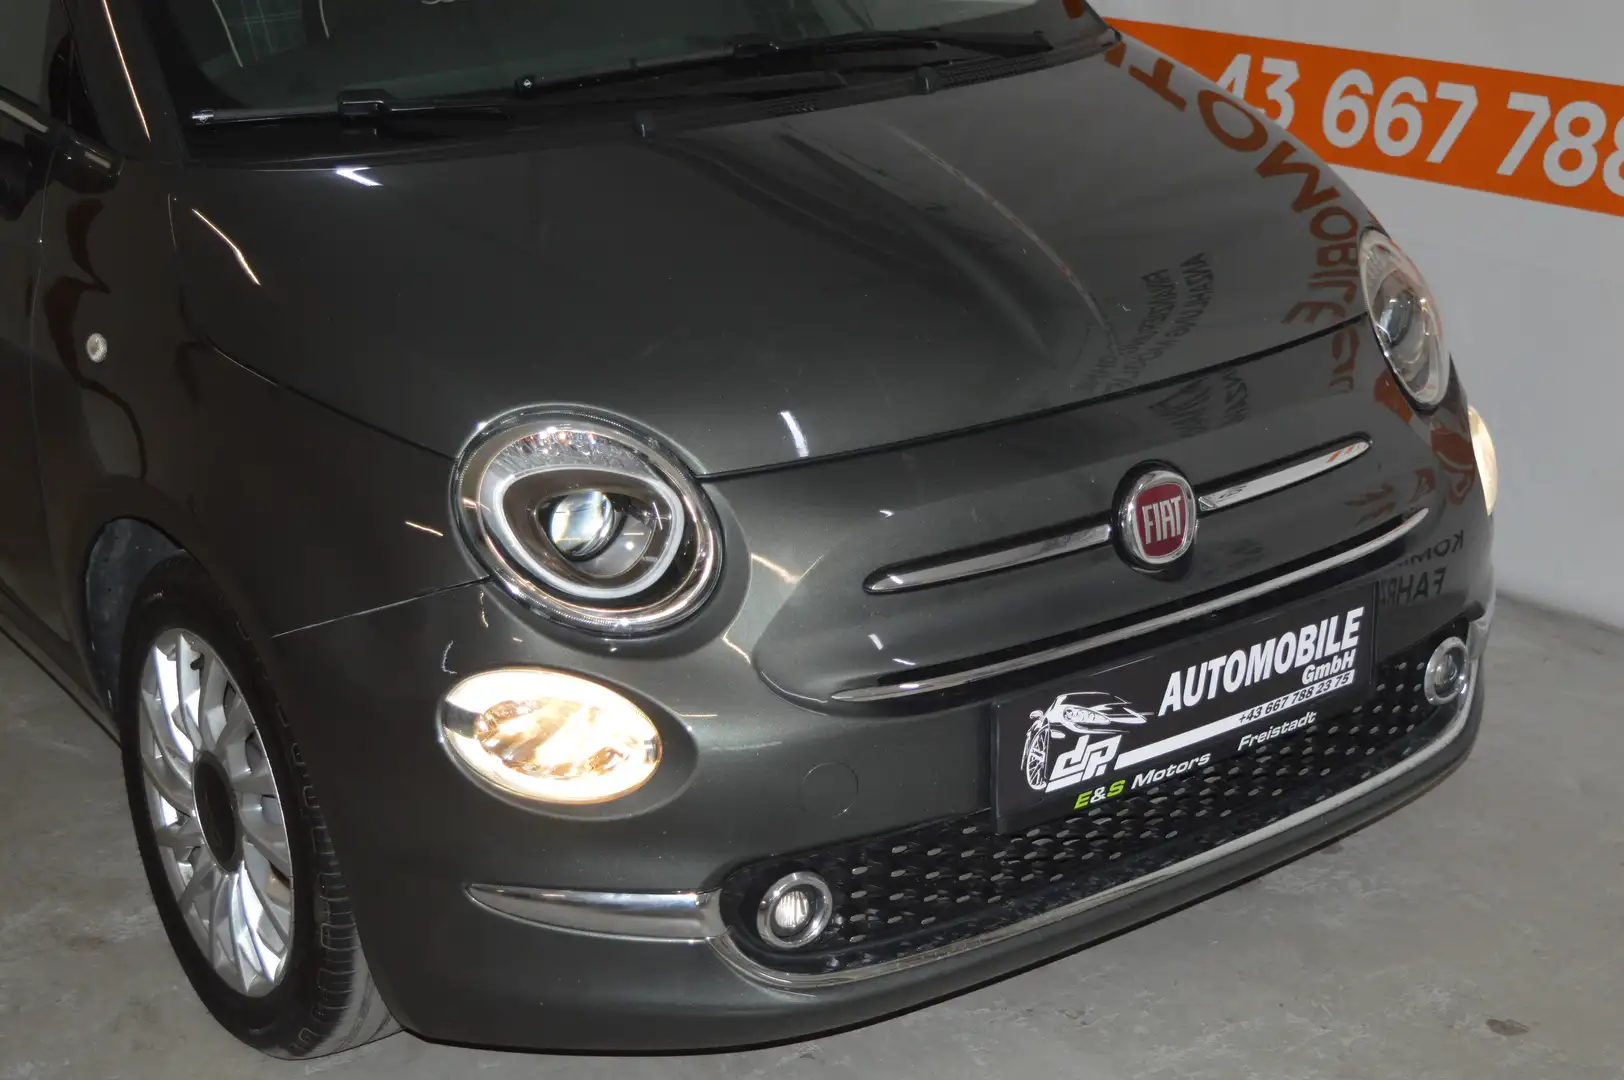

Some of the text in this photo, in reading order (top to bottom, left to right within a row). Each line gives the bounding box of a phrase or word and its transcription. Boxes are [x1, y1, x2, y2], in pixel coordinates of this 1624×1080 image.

[1216, 53, 1300, 131] 43
[1322, 68, 1479, 164] 667
[1142, 496, 1182, 545] FIAT
[1158, 606, 1365, 717] AUTOMOBILE
[1239, 671, 1351, 724] +43 667 788 23 75
[1302, 648, 1357, 685] GmbH
[1074, 711, 1317, 810] E&S Motors Freistadt
